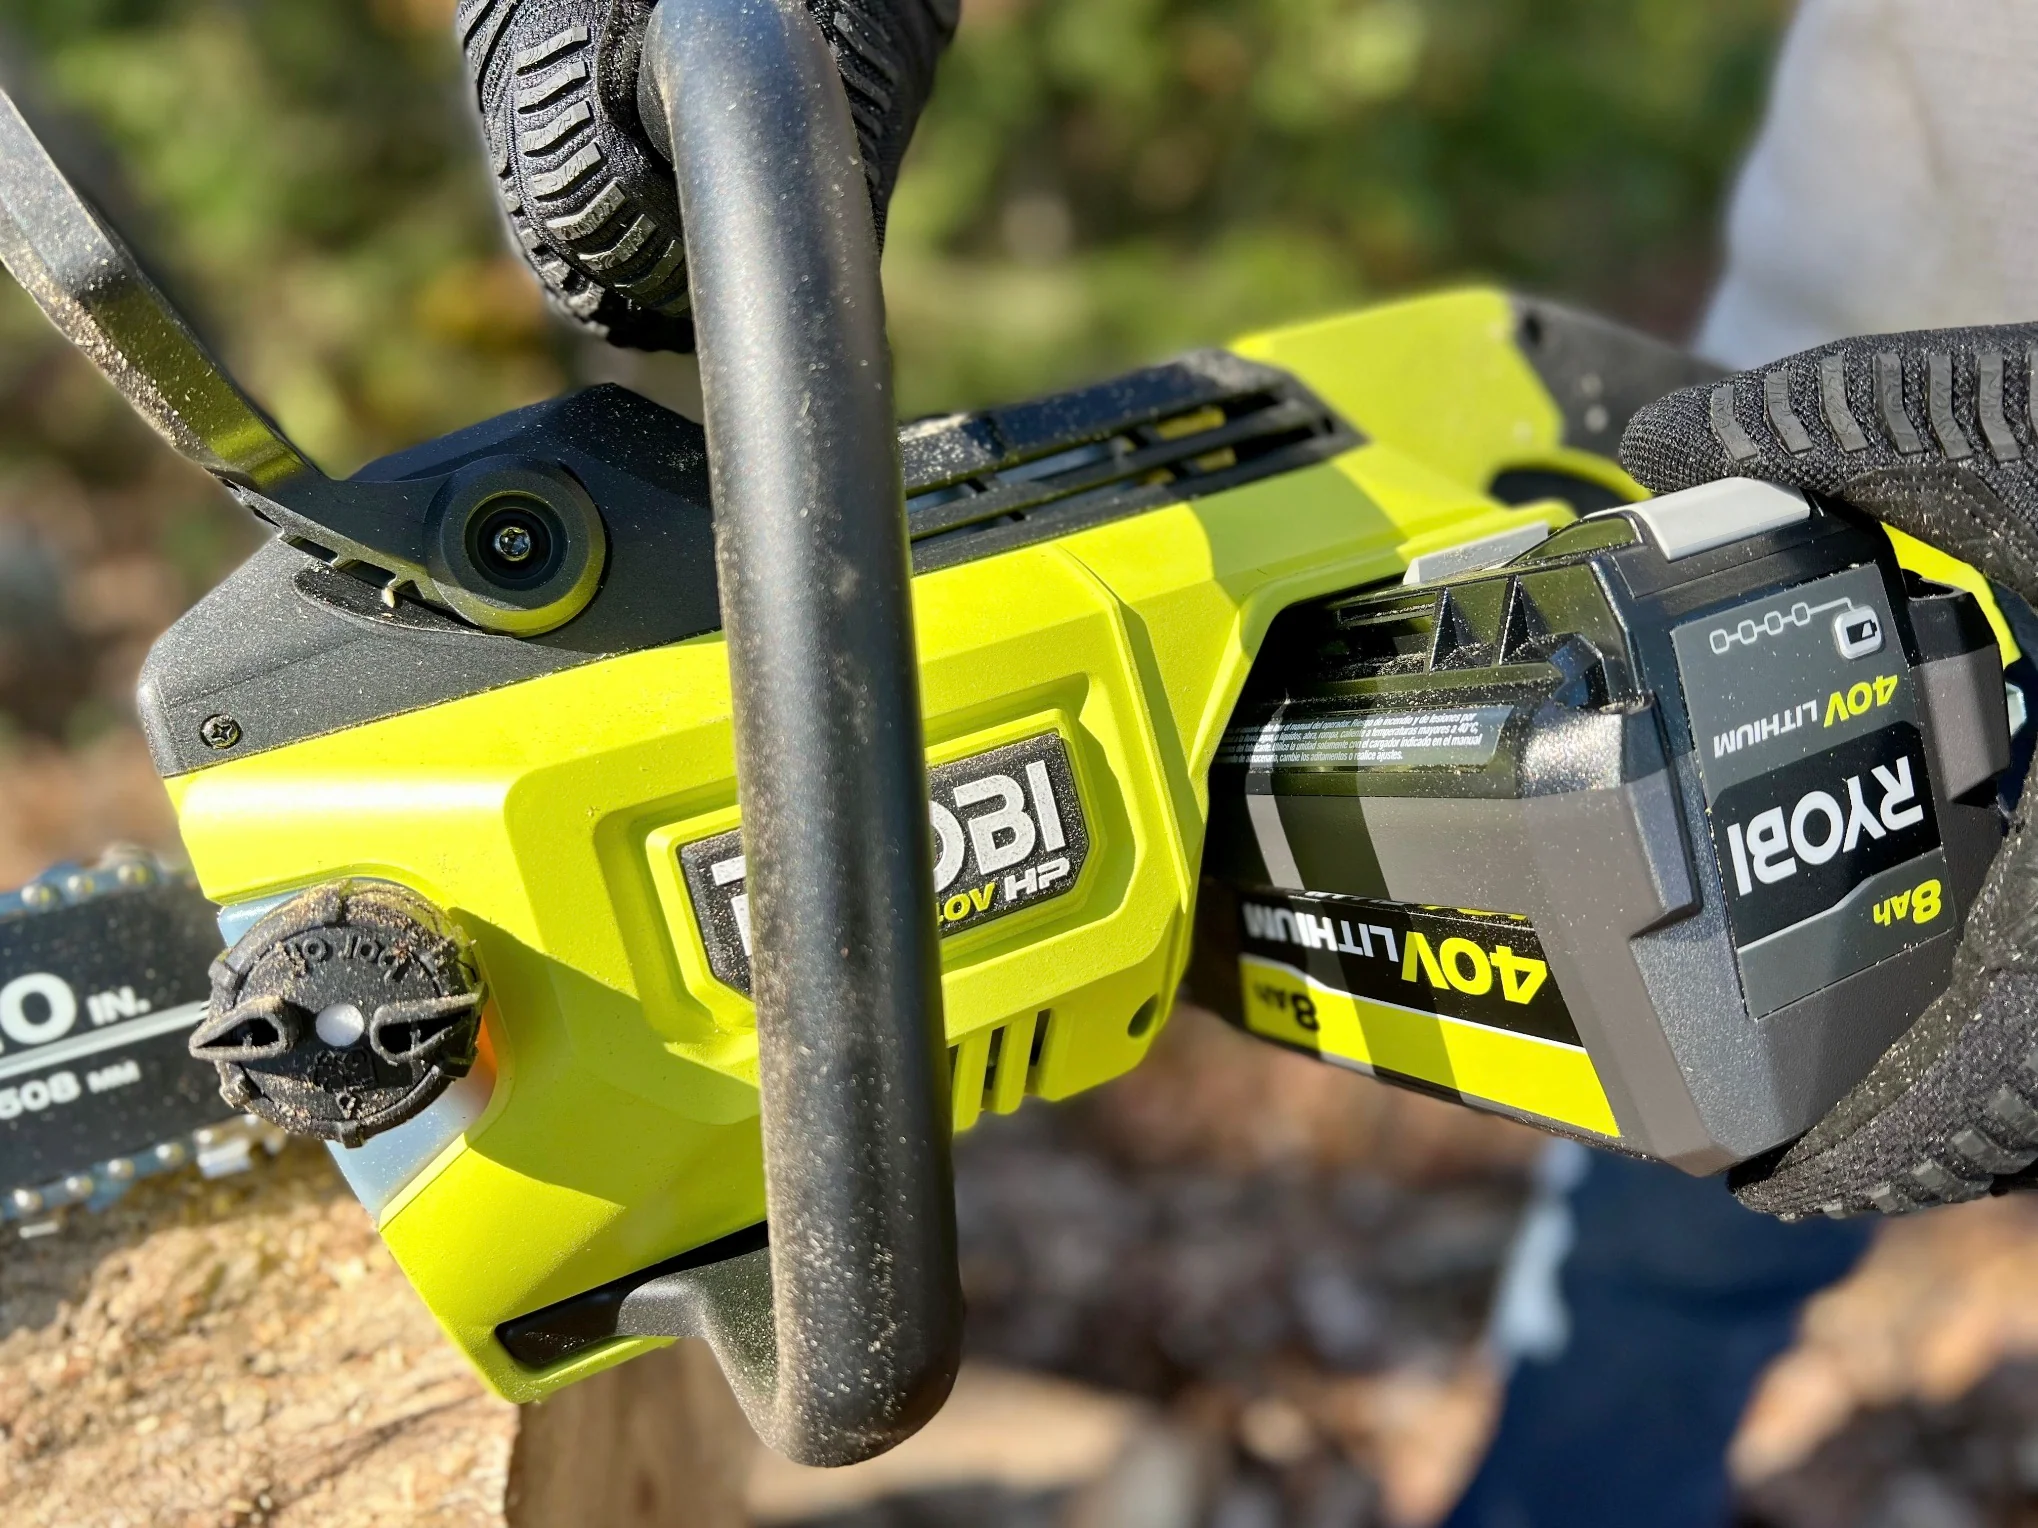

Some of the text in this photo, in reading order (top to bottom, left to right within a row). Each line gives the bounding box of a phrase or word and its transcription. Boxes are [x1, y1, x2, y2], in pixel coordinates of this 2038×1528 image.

[1316, 740, 1349, 750] solamente
[1348, 739, 1362, 749] con
[1361, 738, 1370, 748] el
[1369, 737, 1401, 750] cargador
[1400, 736, 1432, 747] indicado
[1432, 737, 1443, 746] en
[1442, 735, 1452, 746] el
[1451, 733, 1483, 746] manual
[1339, 728, 1366, 738] caliente
[1371, 726, 1418, 738] temperaturas
[1417, 724, 1451, 736] mayores
[1450, 725, 1458, 734] a
[1373, 717, 1384, 726] de
[1383, 715, 1414, 726] incendio
[1419, 714, 1430, 724] de
[1429, 713, 1462, 723] lesiones
[1460, 713, 1478, 723] por
[1713, 674, 1898, 759] 40V LITHIUM
[1300, 752, 1310, 761] los
[1310, 751, 1348, 761] aditamentos
[1353, 750, 1377, 761] realice
[1376, 750, 1403, 762] ajustes.
[1726, 755, 1924, 897] RYOBI
[935, 856, 1071, 923] 0V HP
[1872, 878, 1942, 927] 8Ah
[1242, 902, 1548, 1005] 40V LITHIUM
[0, 972, 151, 1055] 0 IN.
